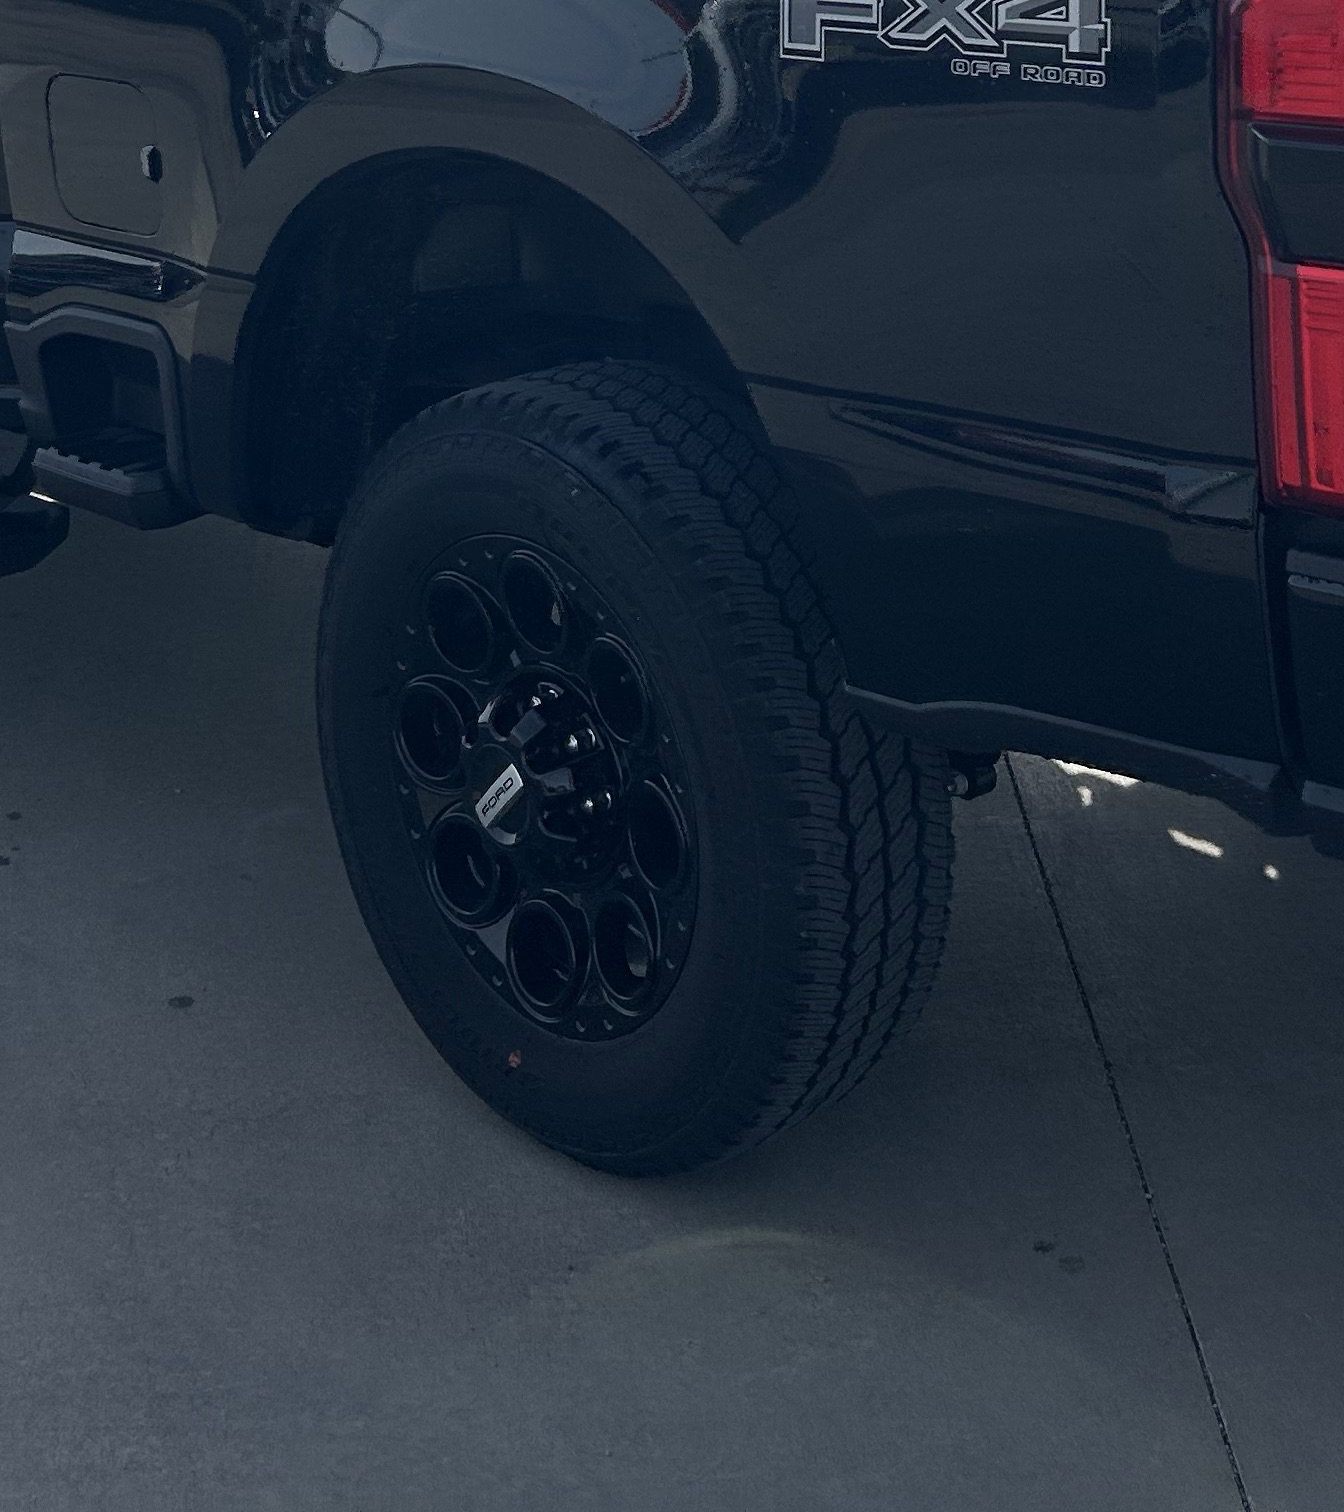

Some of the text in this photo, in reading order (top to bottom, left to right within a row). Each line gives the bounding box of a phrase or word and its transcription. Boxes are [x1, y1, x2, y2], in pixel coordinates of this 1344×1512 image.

[950, 59, 1106, 88] OFF ROAD
[482, 777, 514, 817] FORD
